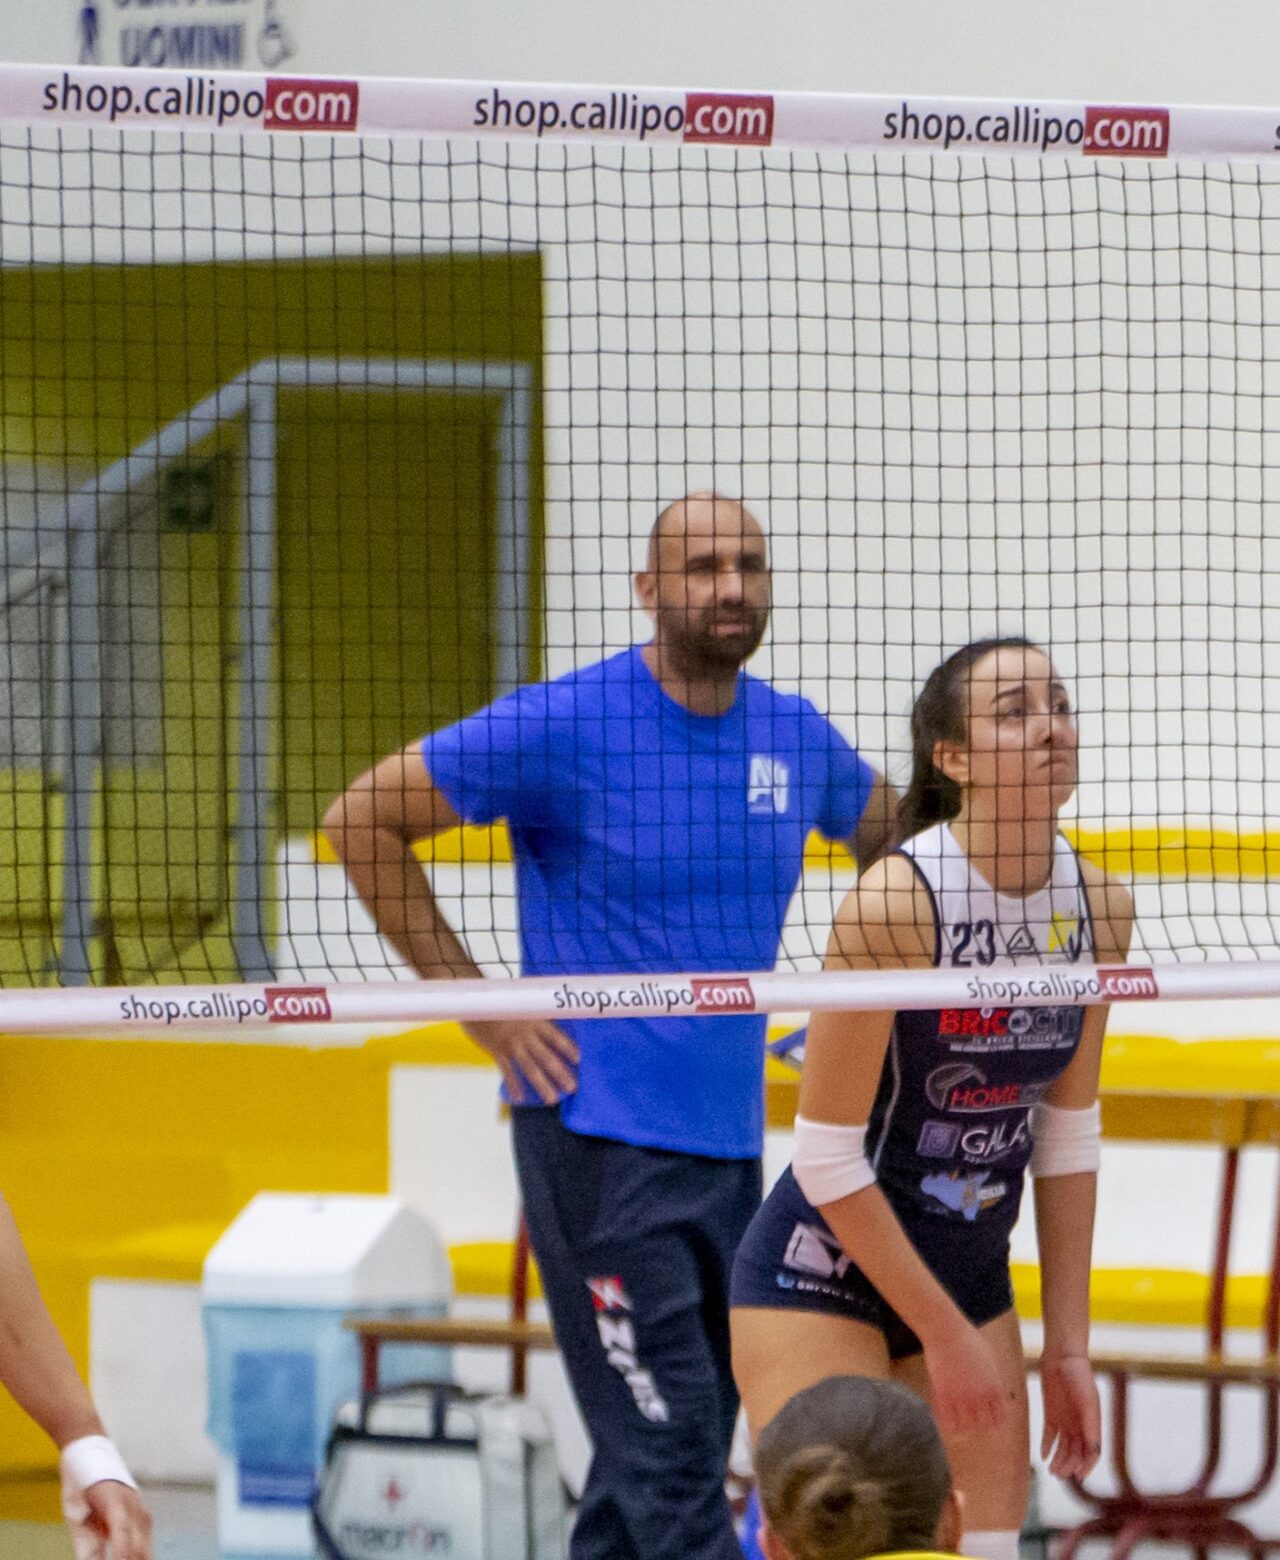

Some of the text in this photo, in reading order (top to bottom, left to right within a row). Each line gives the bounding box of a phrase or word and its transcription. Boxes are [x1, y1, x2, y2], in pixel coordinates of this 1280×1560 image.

[119, 23, 245, 68] UOMINI
[43, 73, 352, 126] shop.callipo.com
[473, 88, 768, 140] shop.callipo.com
[883, 101, 1162, 152] shop.callipo.com
[950, 918, 996, 967] 23
[120, 992, 328, 1025] shop.callipo.com
[553, 983, 751, 1014] shop.callipo.com
[967, 973, 1154, 1003] shop.callipo.com
